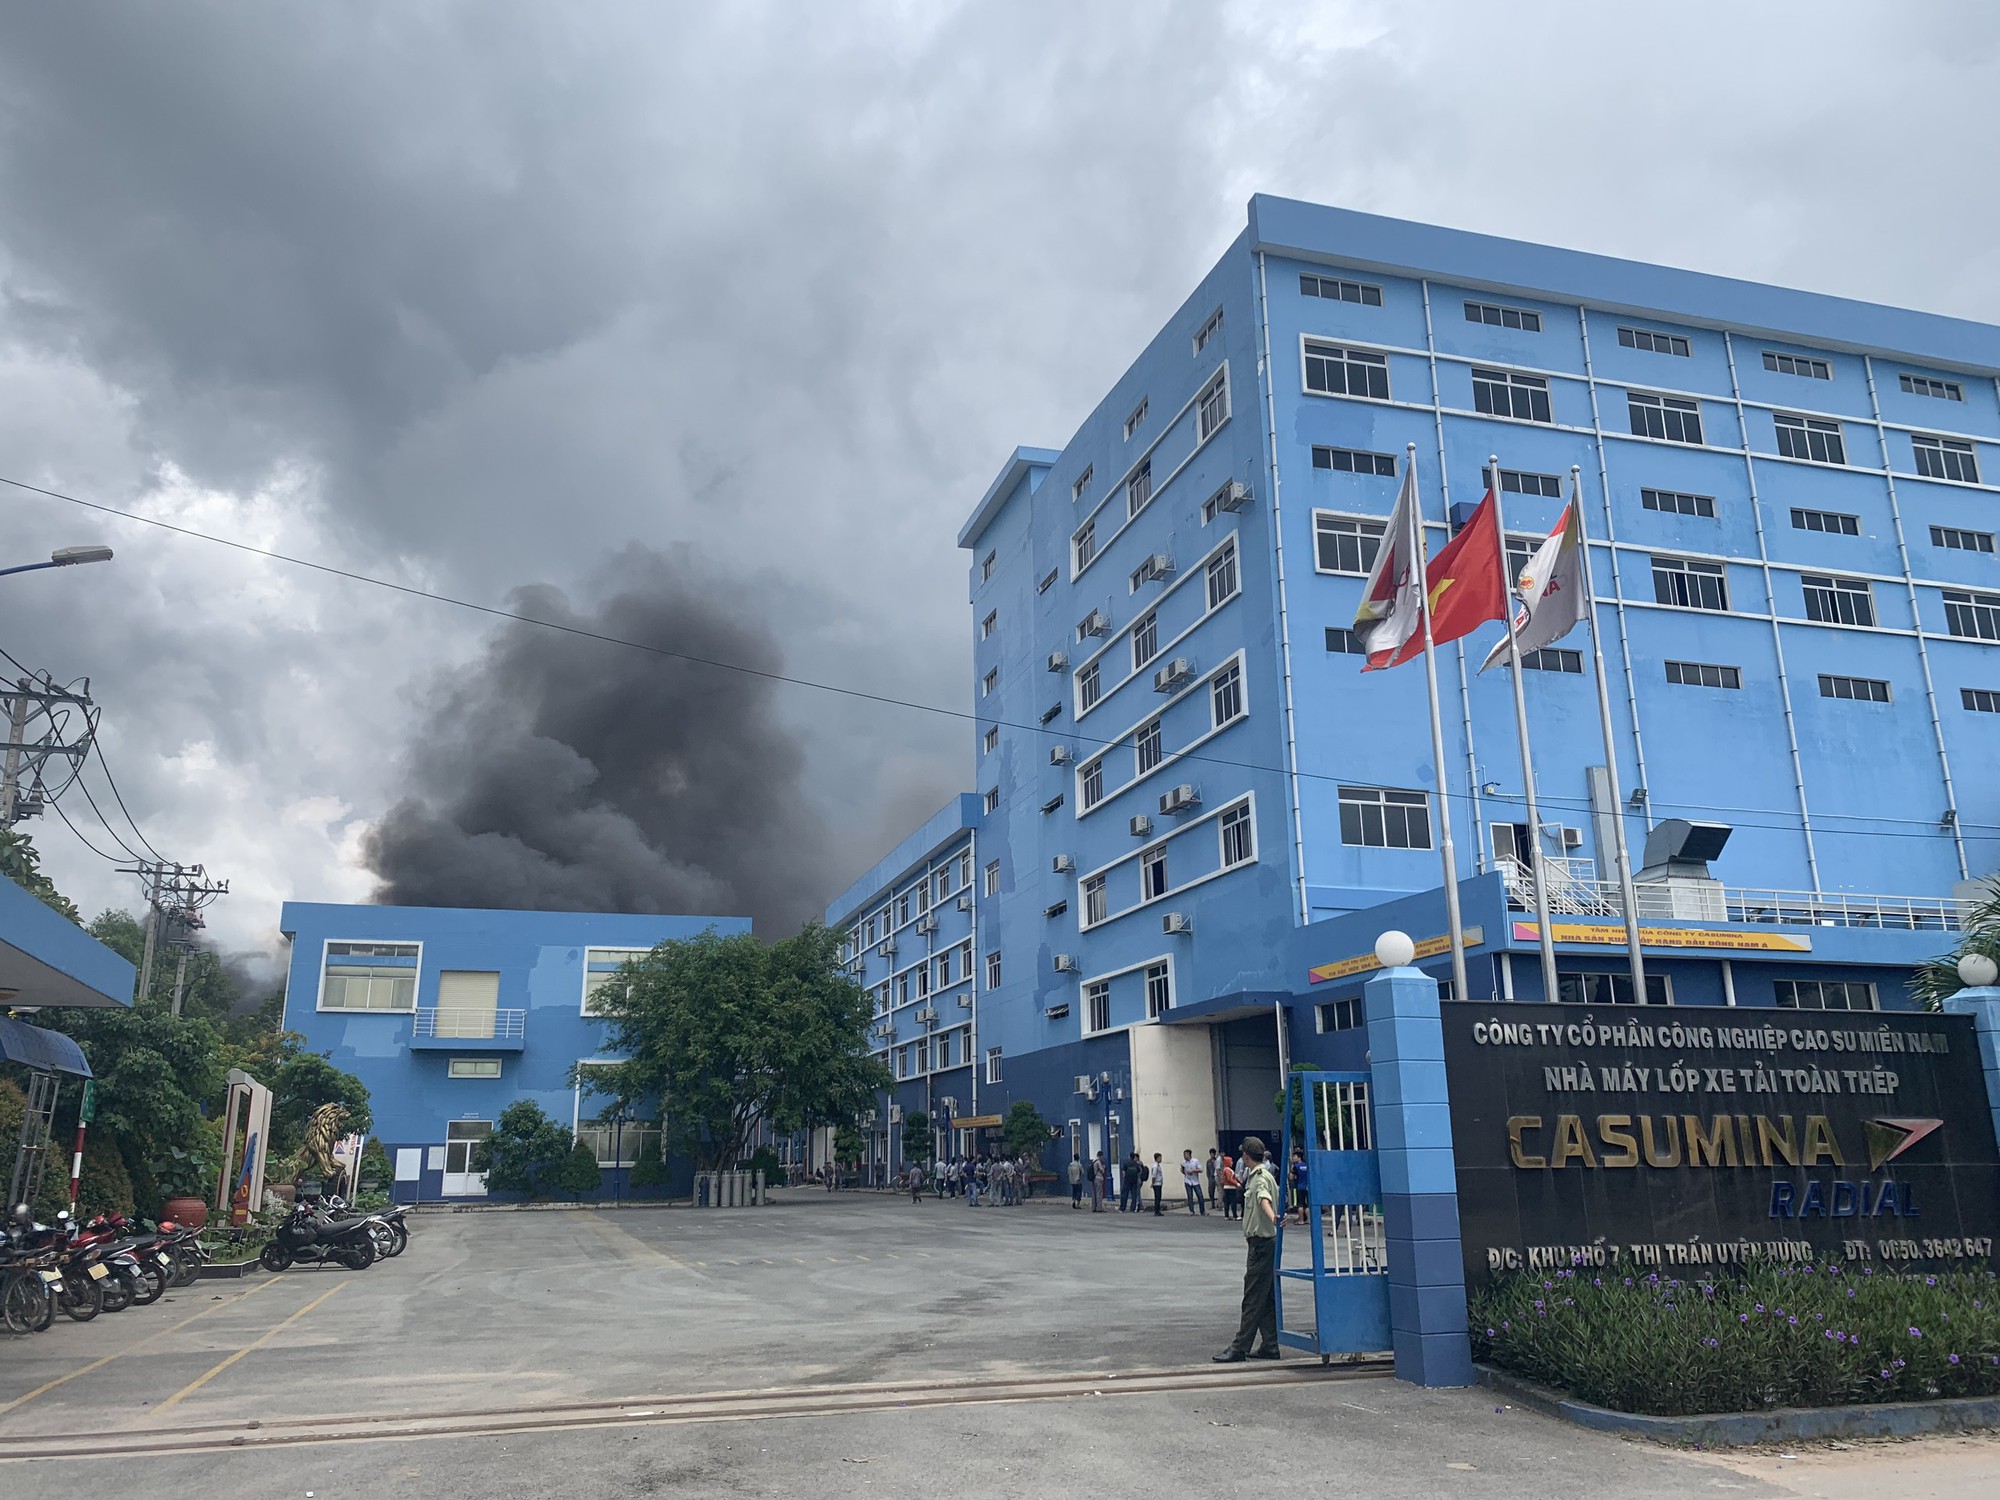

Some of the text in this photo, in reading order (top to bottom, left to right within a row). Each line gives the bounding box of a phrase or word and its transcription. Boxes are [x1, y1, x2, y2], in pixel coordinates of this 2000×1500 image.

[1473, 1014, 1950, 1056] CÔNG TY CỔ PHẦN CÔNG NGHIỆP CAO SU MIỀN NAM
[1542, 1058, 1900, 1094] NHÀ MÁY LỐP XE TẢI TOÀN THÉP
[1506, 1114, 1846, 1169] CASUMINA
[1768, 1180, 1921, 1219] RADIAL
[1487, 1246, 1523, 1269] Đ/C:
[1526, 1245, 1565, 1268] KHU
[1568, 1236, 1606, 1267] PHỐ
[1608, 1245, 1620, 1263] 7
[1629, 1243, 1662, 1271] THỊ
[1663, 1234, 1713, 1265] TRẤN
[1714, 1236, 1762, 1264] UYÊN
[1843, 1240, 1872, 1261] ĐT:
[1964, 1237, 1992, 1257] 647
